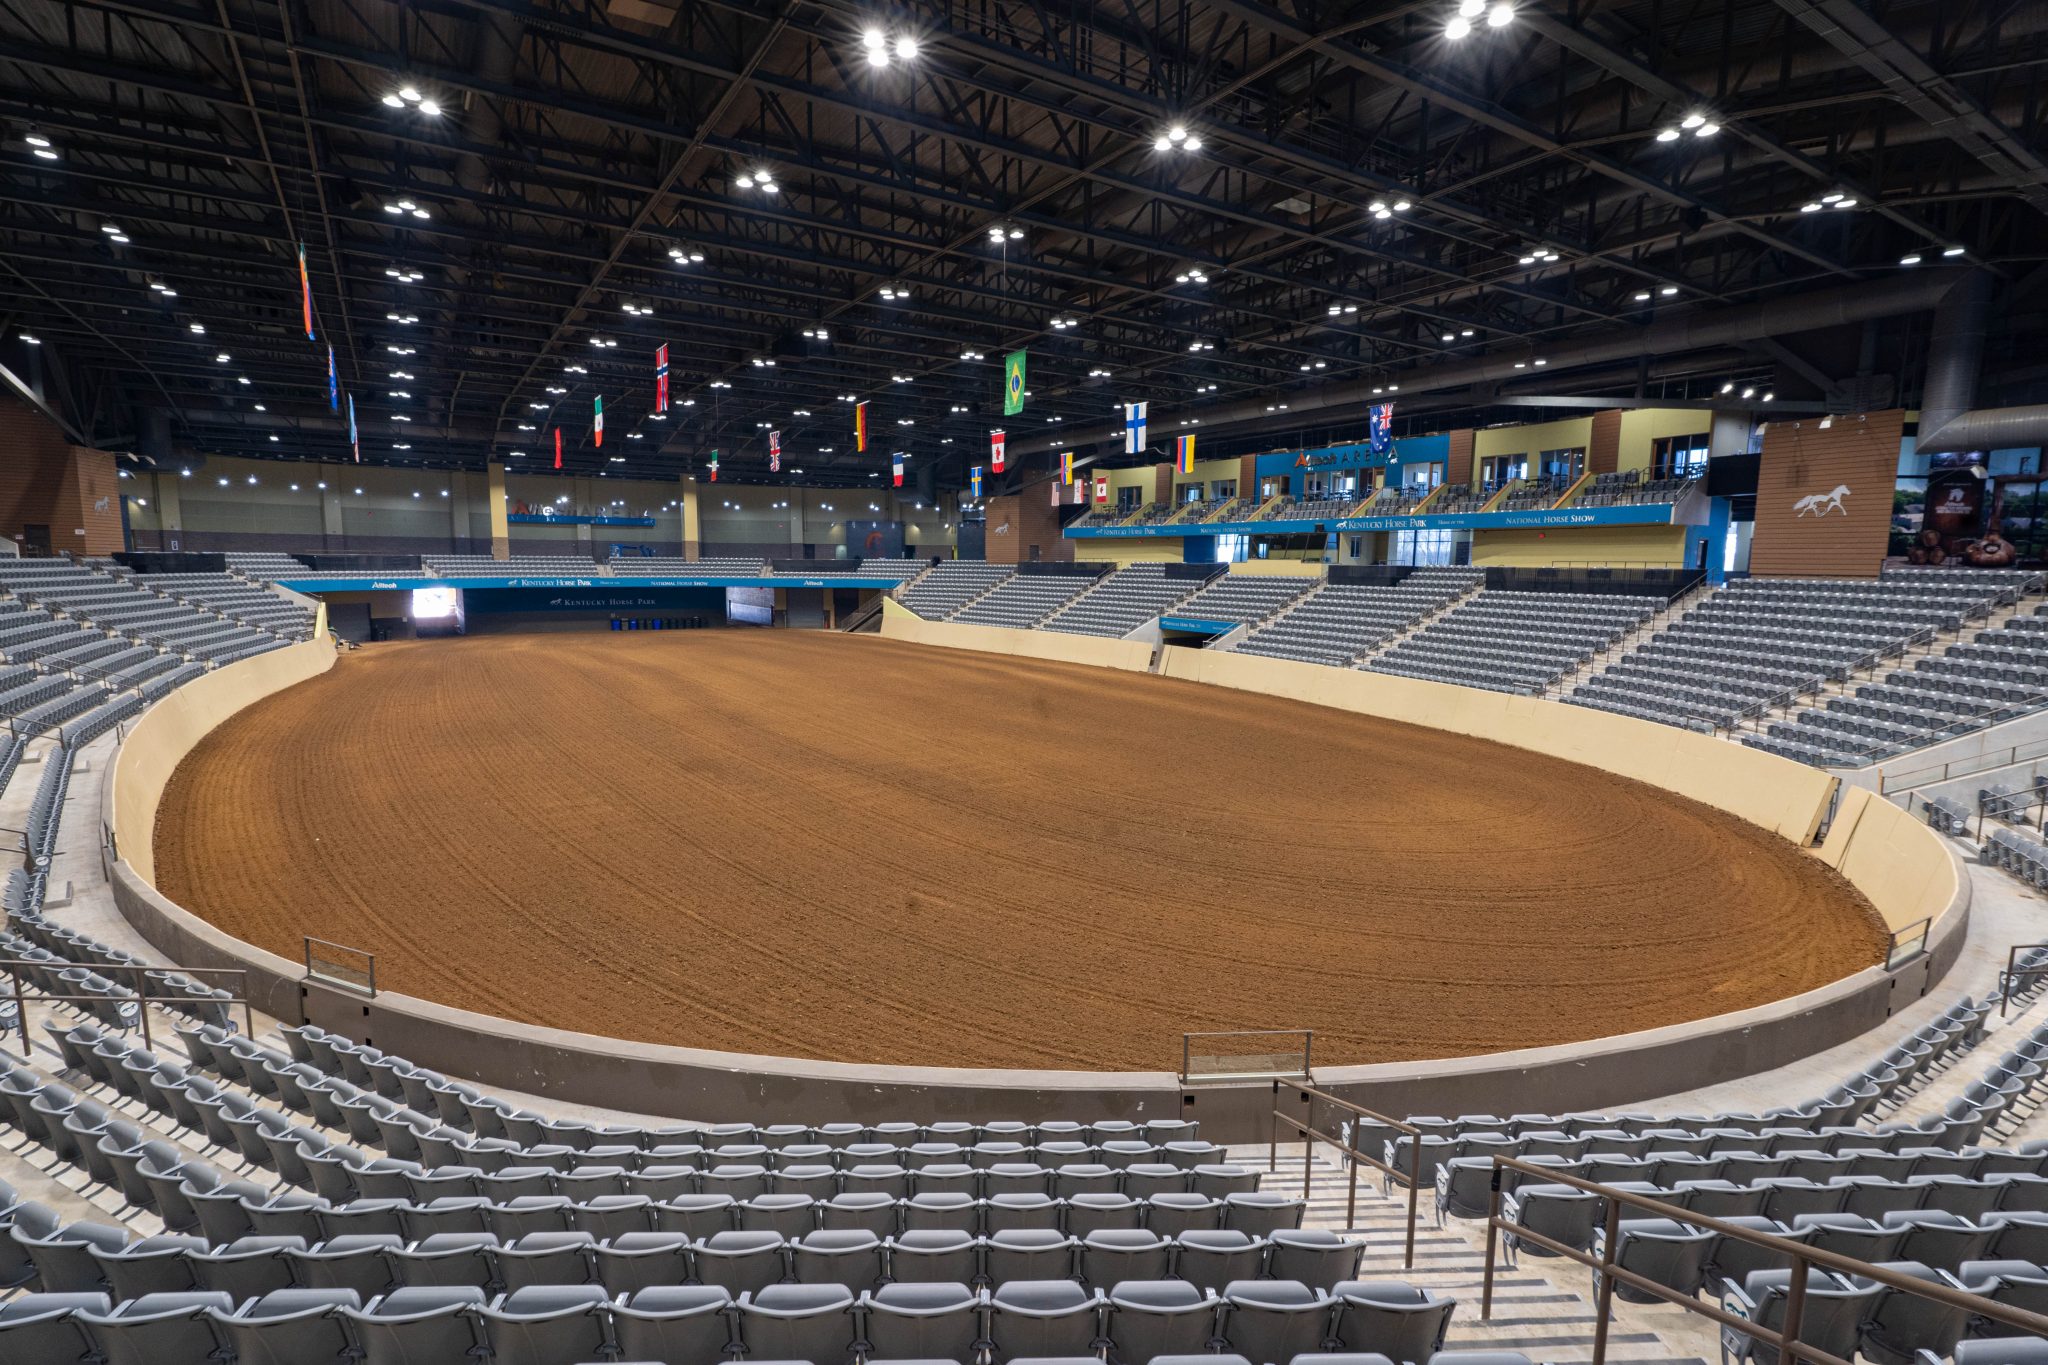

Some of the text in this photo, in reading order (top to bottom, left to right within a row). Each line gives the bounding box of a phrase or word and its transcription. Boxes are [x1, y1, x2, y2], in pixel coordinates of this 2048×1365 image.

[1348, 518, 1427, 529] KENTUCKY HORSE PARK
[1506, 514, 1595, 525] NATIONAL HORSE SHOW
[564, 598, 606, 606] KENTUCKY
